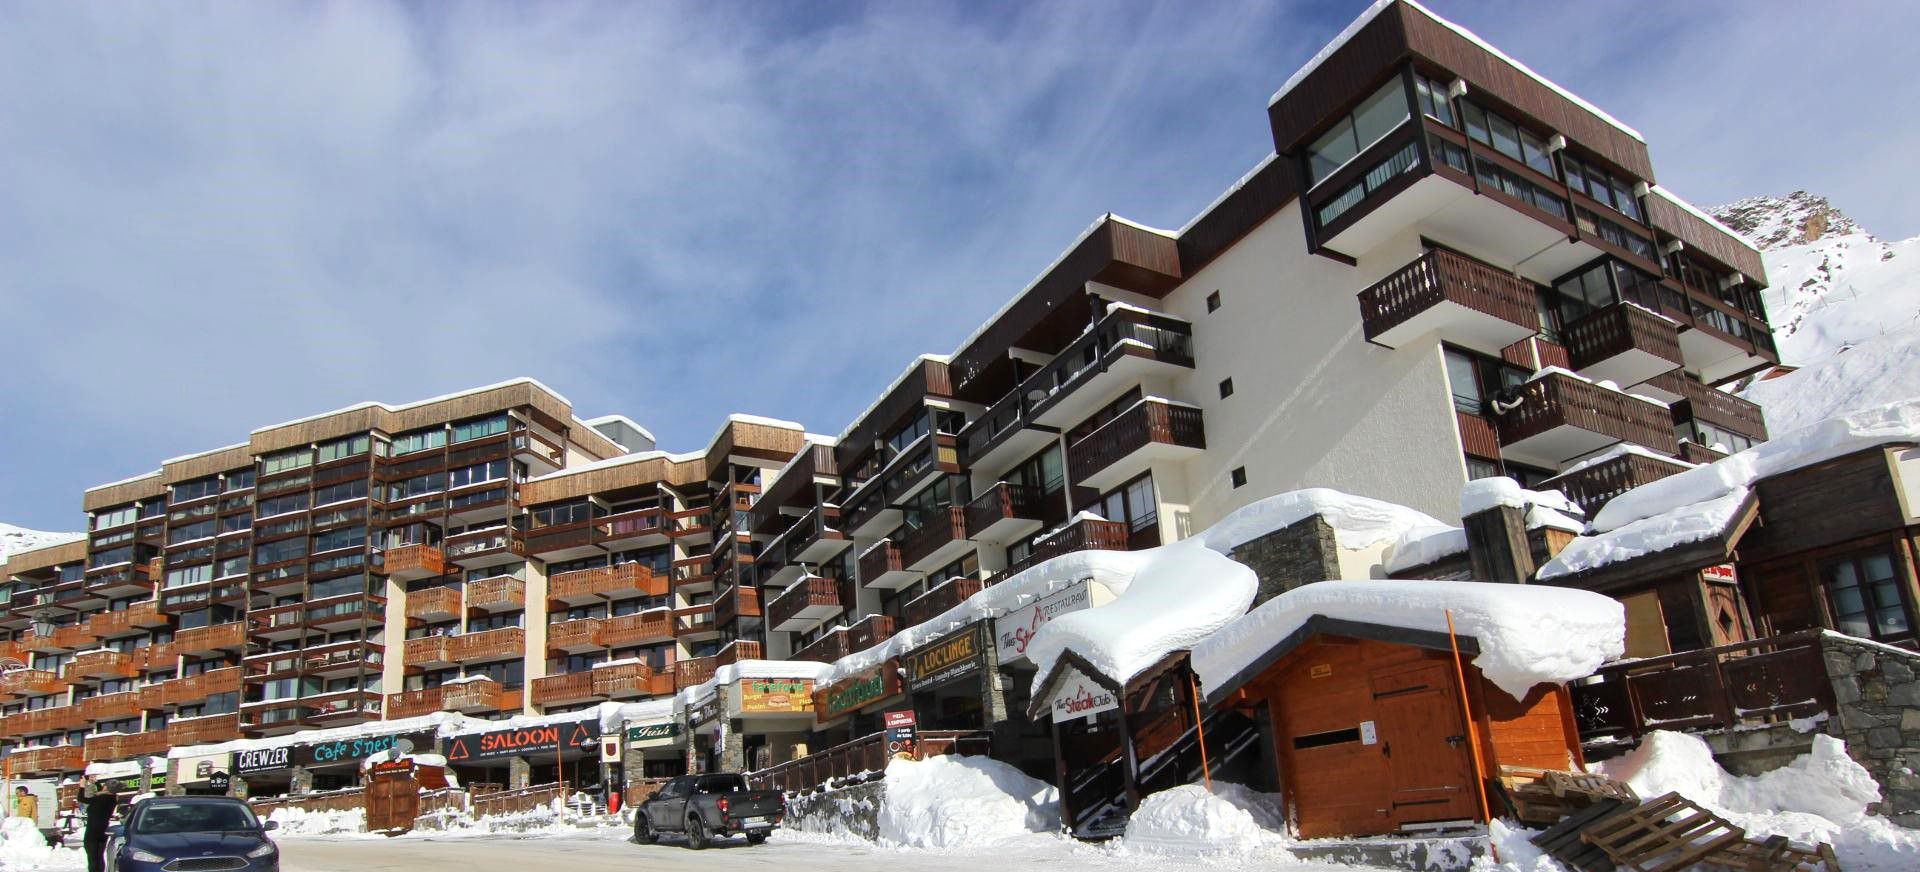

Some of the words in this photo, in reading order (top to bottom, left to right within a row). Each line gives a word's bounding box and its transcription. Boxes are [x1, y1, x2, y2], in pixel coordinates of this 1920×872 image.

[1065, 692, 1095, 714] Steak
[1094, 693, 1111, 707] Club
[481, 727, 558, 751] SALOON
[633, 726, 670, 738] Irish
[239, 747, 288, 769] CREWZER
